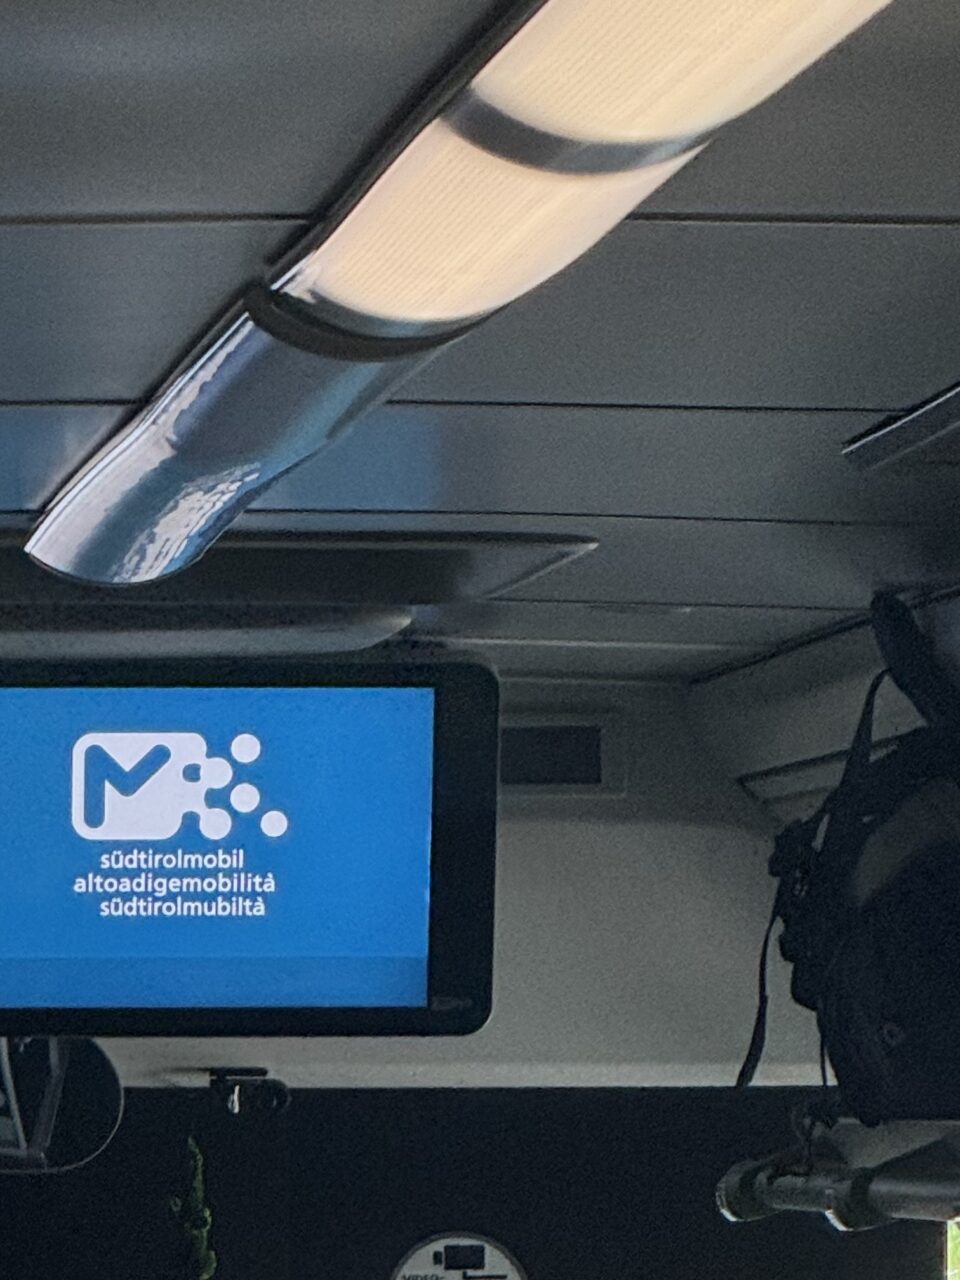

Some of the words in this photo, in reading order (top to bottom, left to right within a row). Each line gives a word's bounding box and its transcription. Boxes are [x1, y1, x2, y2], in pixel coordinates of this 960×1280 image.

[101, 849, 243, 869] südtirolmobil
[74, 872, 275, 898] altoadigemobilità
[100, 895, 265, 916] südtirolmubiltà
